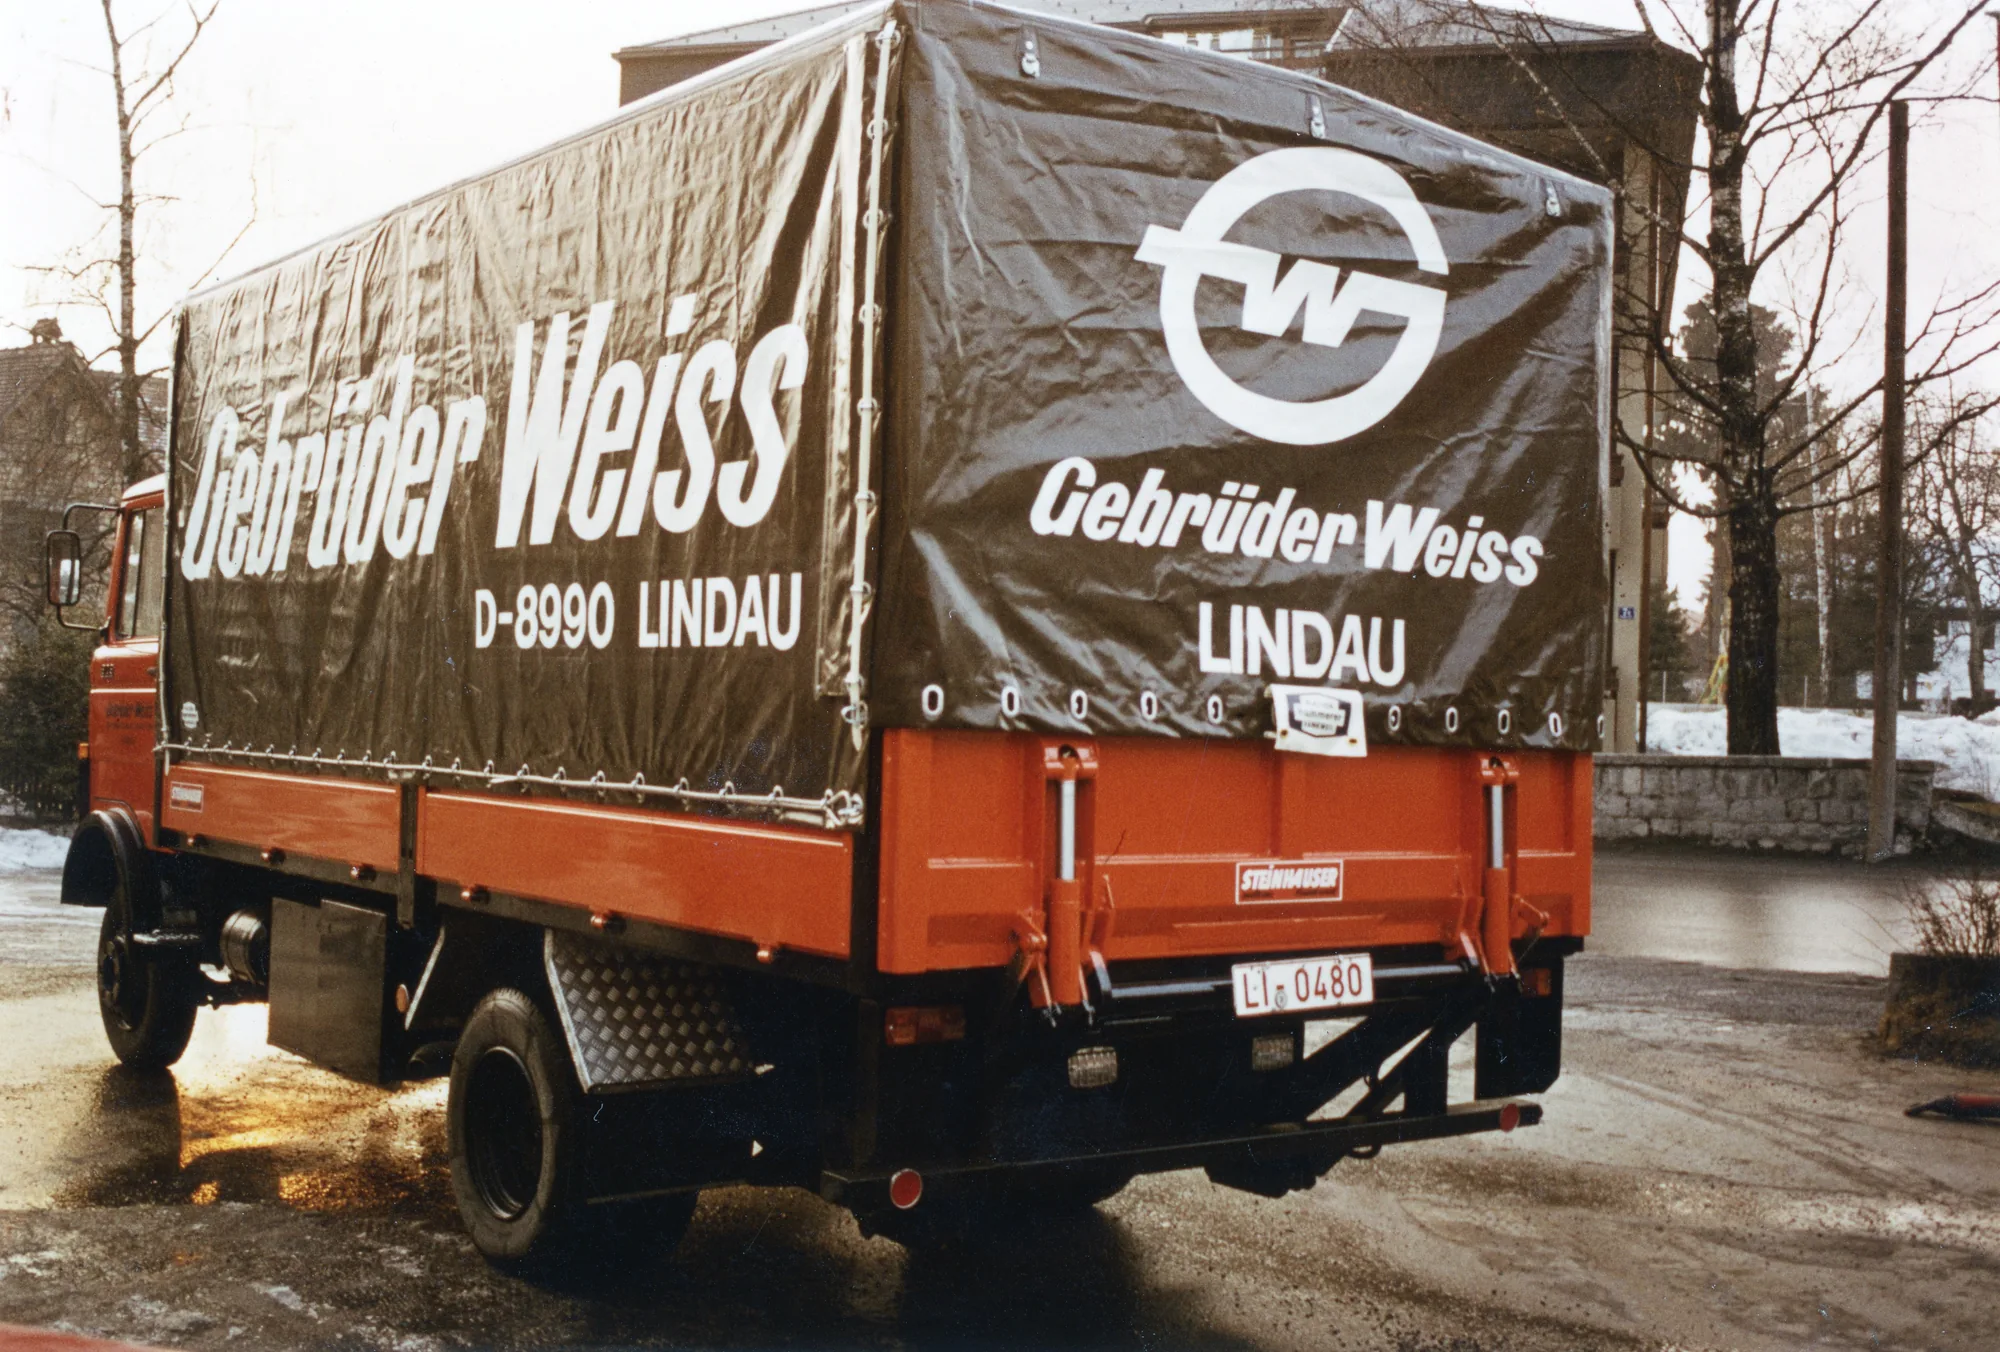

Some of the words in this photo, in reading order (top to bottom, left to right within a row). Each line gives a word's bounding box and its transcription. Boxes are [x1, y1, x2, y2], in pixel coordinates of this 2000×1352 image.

[181, 351, 487, 581] Gebrüder
[495, 292, 809, 549] Weiss
[1029, 456, 1358, 564] Gebrüder
[1364, 499, 1544, 587] Weiss
[475, 580, 615, 649] D-8990
[639, 573, 802, 651] LINDAU
[1199, 601, 1405, 687] LINDAU
[1240, 863, 1339, 892] STEINHAUSER
